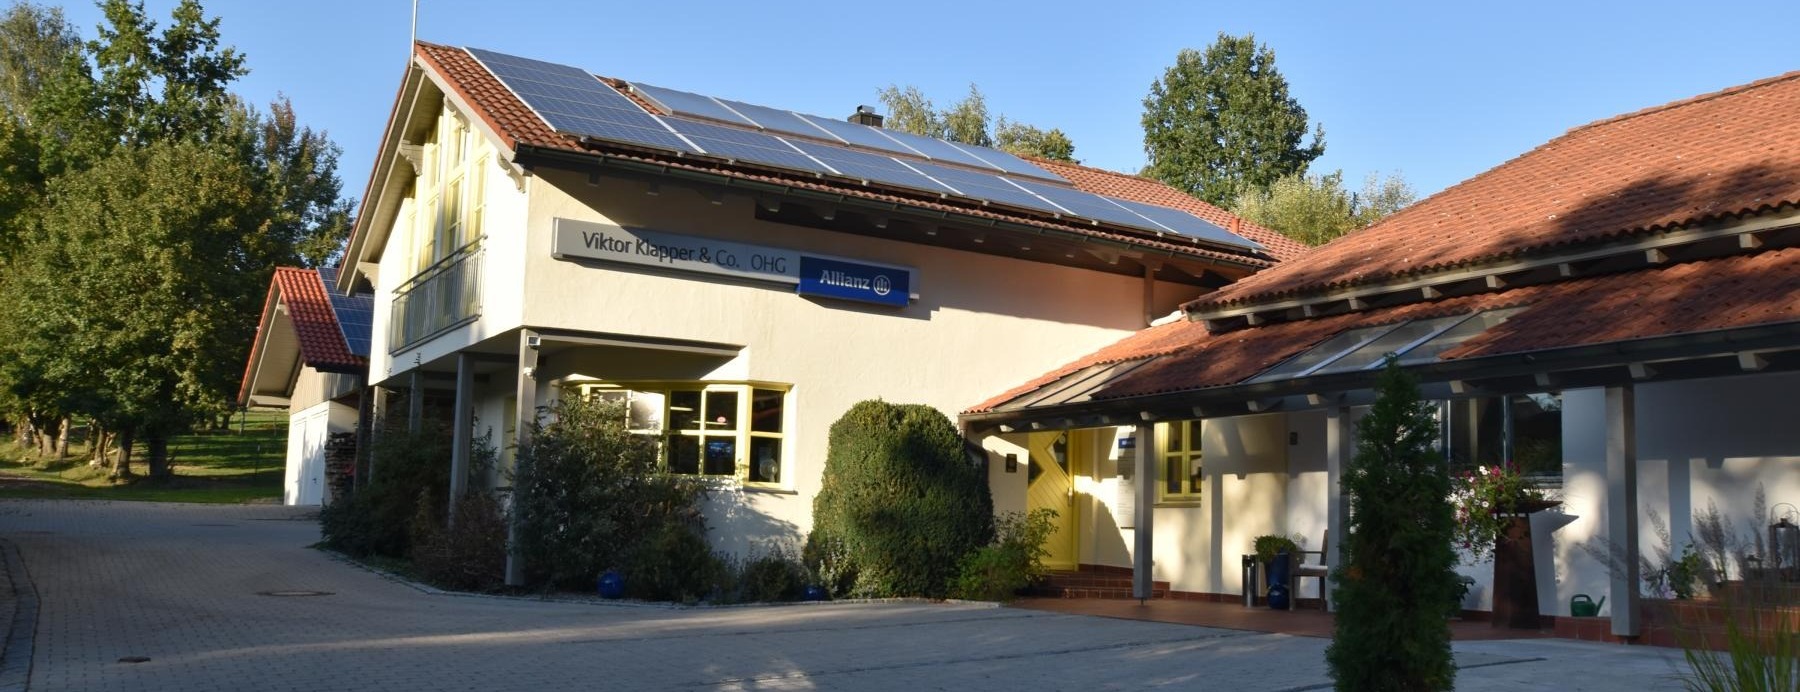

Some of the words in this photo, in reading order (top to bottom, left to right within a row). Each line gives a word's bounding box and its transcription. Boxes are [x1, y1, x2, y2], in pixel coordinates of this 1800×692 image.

[582, 231, 632, 253] Viktor
[635, 238, 695, 263] Klapper
[699, 247, 711, 263] &
[716, 249, 740, 268] Co.
[751, 254, 786, 273] OHG
[820, 269, 870, 290] Allianz
